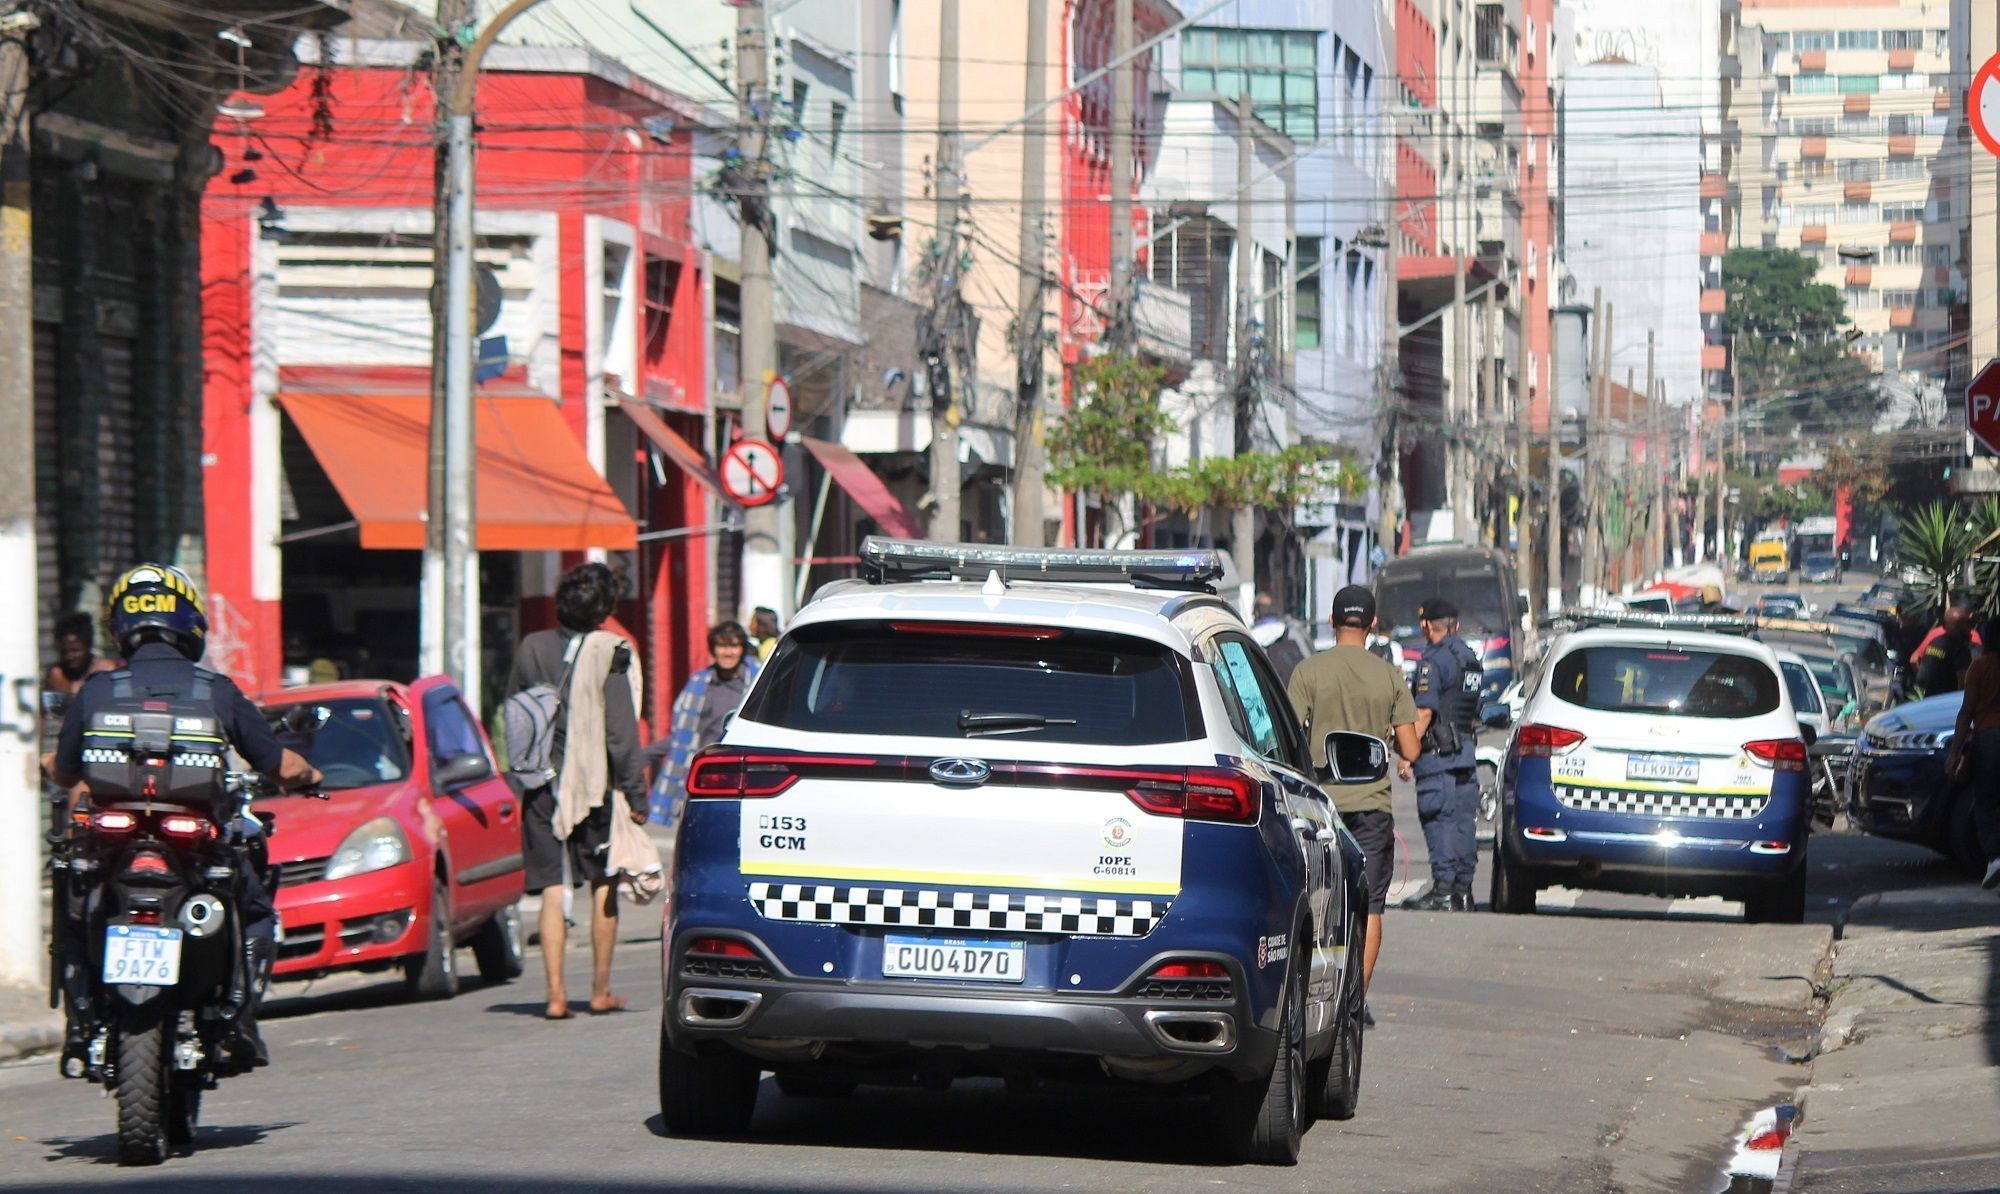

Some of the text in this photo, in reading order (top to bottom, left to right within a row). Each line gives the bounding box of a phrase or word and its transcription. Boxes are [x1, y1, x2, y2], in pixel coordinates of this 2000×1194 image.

[123, 594, 176, 613] GCM
[771, 816, 806, 831] 153
[760, 835, 806, 850] GCM
[1099, 856, 1131, 866] IOPE
[1093, 866, 1136, 876] G-60814
[124, 940, 165, 958] FTW
[116, 960, 169, 978] 9A76
